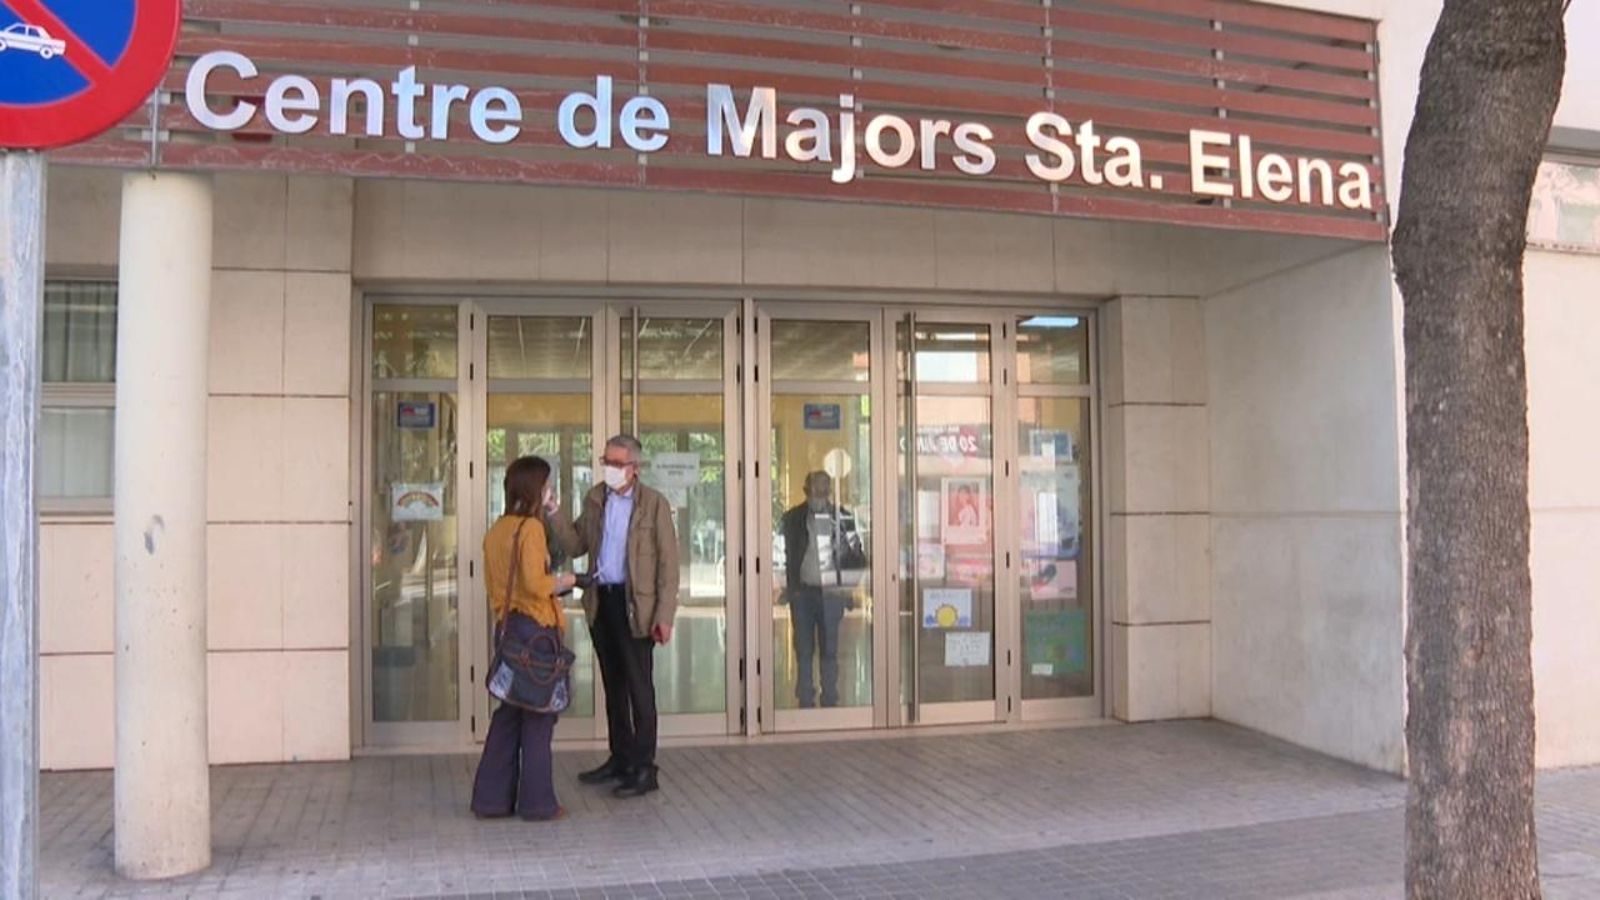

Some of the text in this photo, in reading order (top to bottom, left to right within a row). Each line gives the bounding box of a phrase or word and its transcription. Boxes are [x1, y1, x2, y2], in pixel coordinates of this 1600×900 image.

[184, 51, 1373, 210] Centre de Majors Sta. Elena
